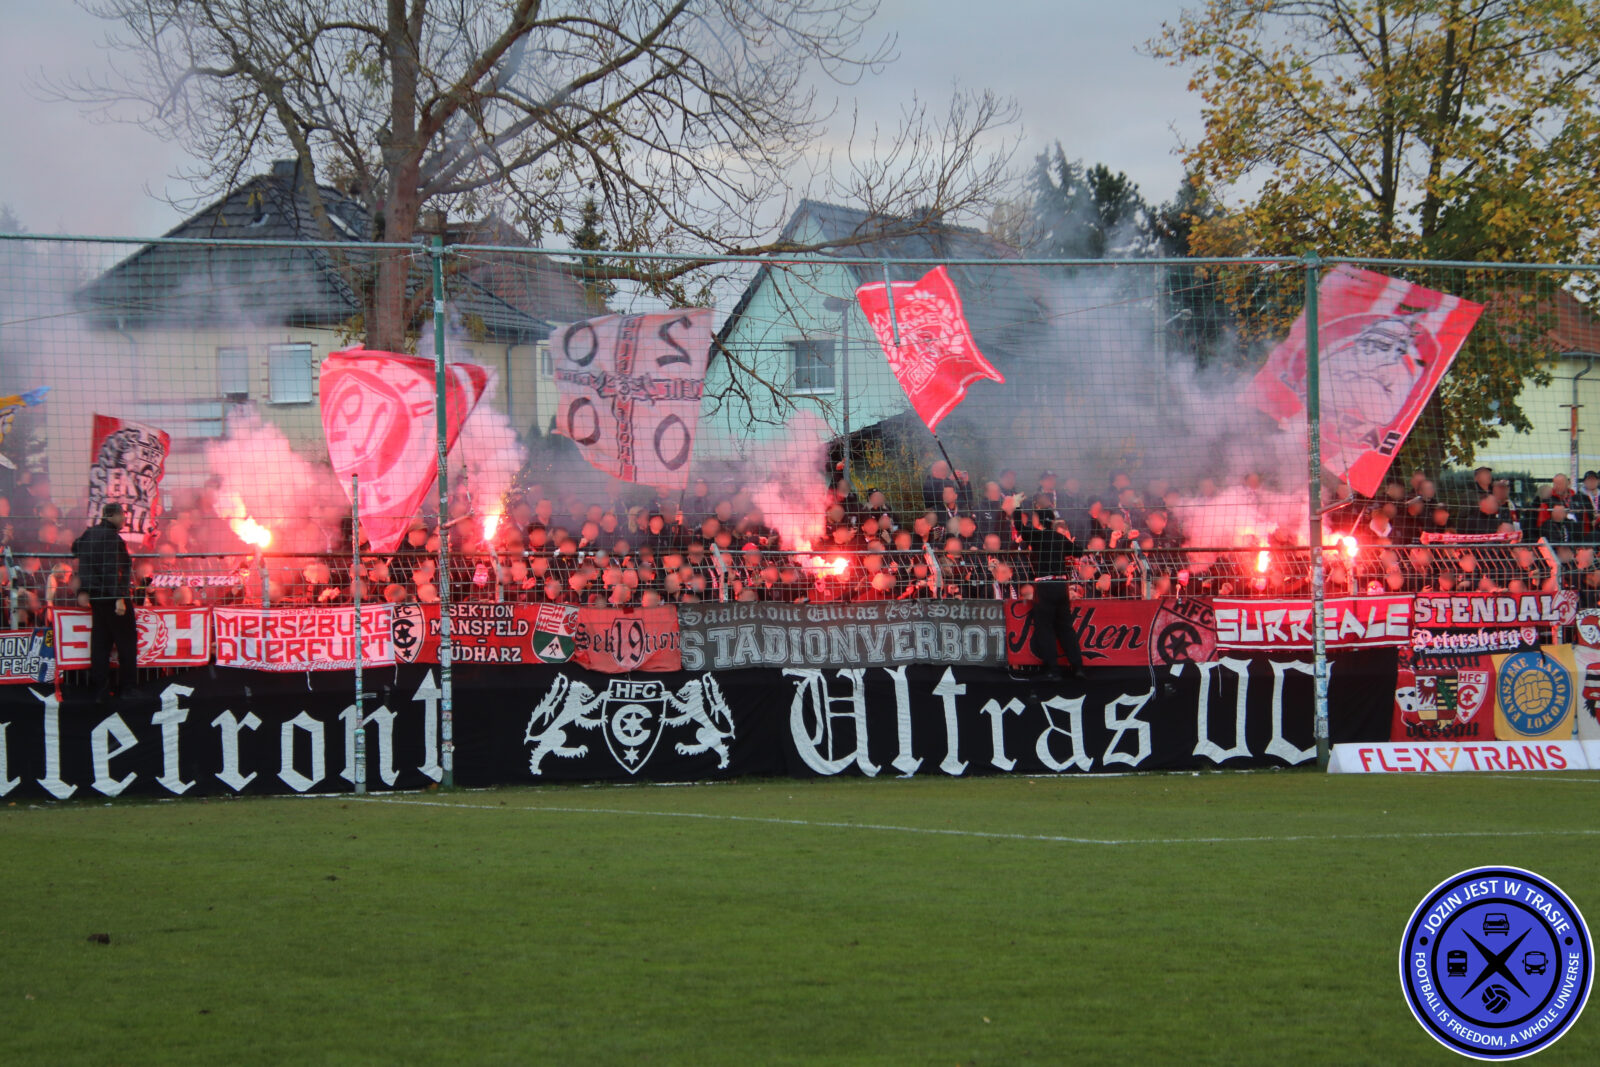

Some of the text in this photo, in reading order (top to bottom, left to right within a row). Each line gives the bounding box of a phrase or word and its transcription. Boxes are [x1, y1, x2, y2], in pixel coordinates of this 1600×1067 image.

[449, 604, 515, 617] SEKTION
[1215, 603, 1410, 642] SURREALE
[1414, 595, 1561, 624] STENDAL
[430, 619, 529, 637] MANSFELD
[1412, 627, 1522, 652] Petersberg
[681, 622, 1007, 670] STADIONVERBOT
[615, 683, 657, 699] HFC
[1459, 673, 1482, 683] HFC
[782, 665, 1155, 777] Ultras
[1358, 745, 1567, 772] FLEX TRANS
